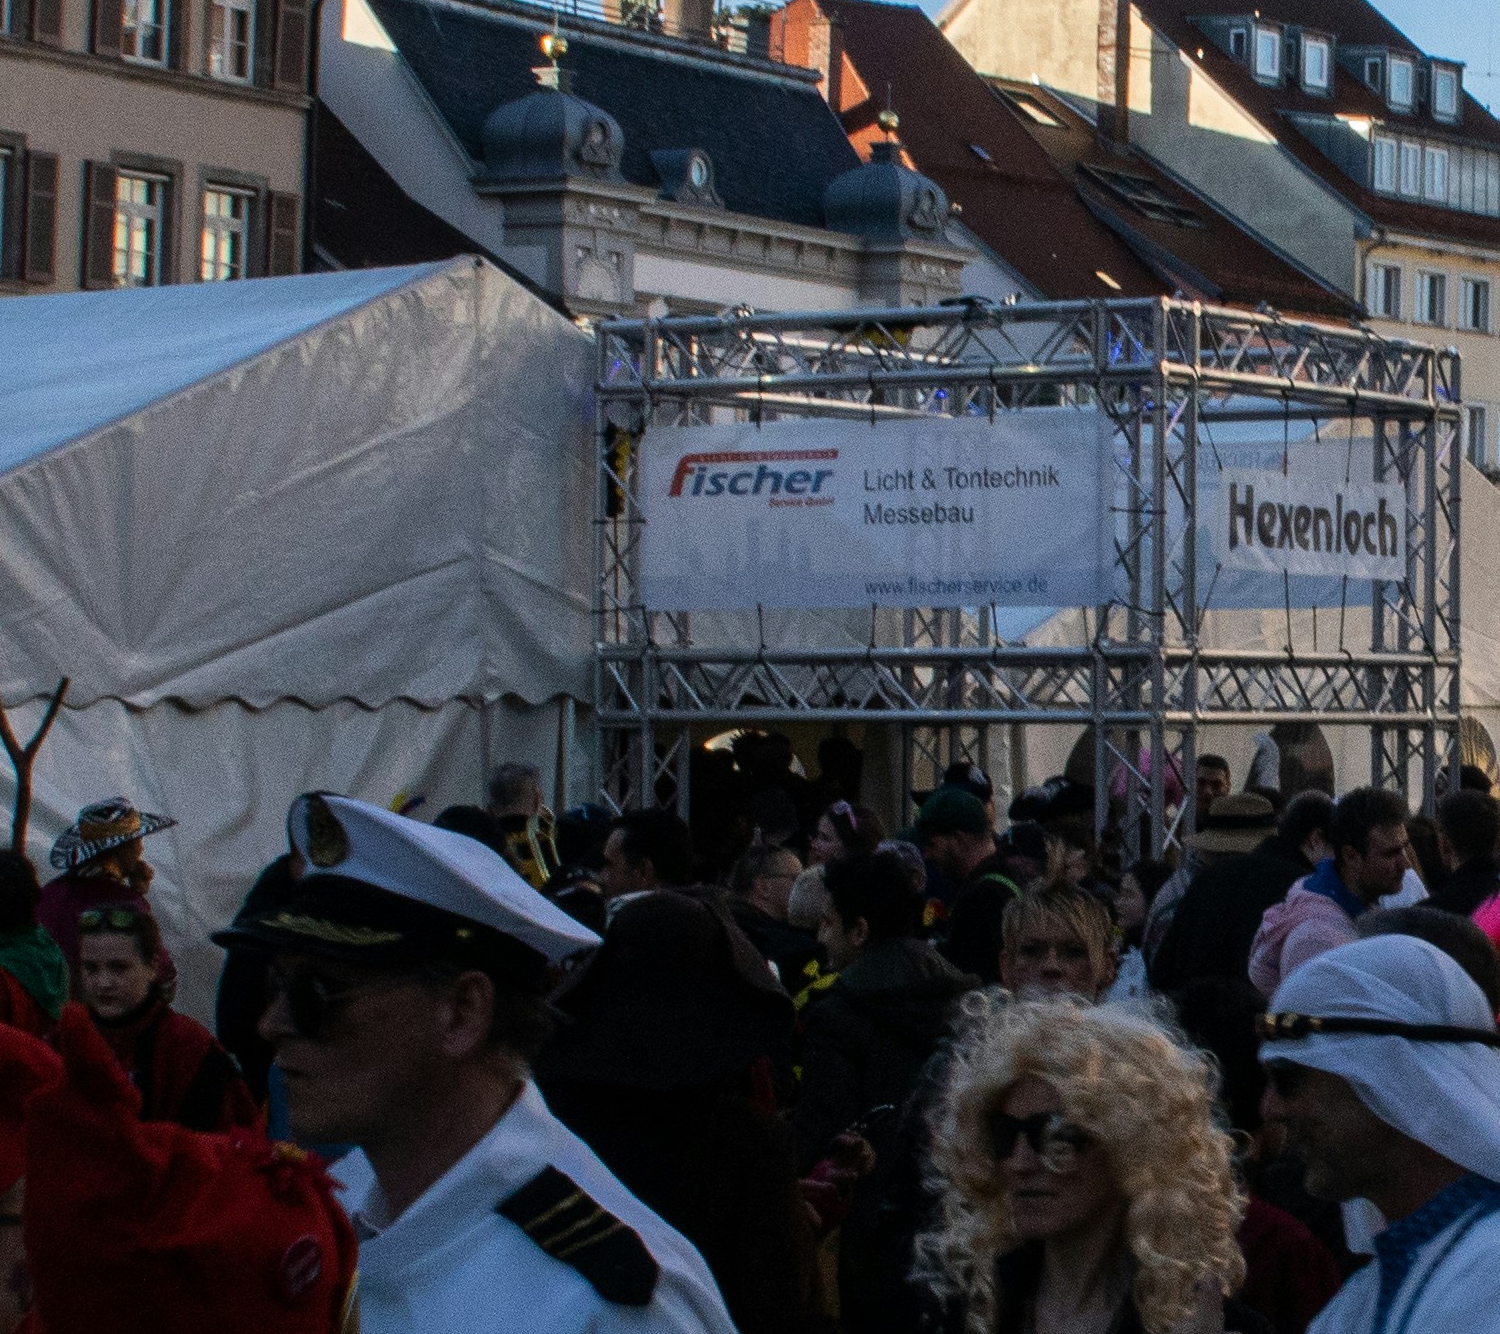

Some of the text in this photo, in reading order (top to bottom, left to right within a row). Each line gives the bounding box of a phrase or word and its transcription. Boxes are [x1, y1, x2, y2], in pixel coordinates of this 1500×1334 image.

[668, 450, 838, 498] fischer
[863, 465, 1060, 492] Licht & Tontechnik
[863, 503, 975, 525] Messebau
[1228, 482, 1398, 558] Hexenloch
